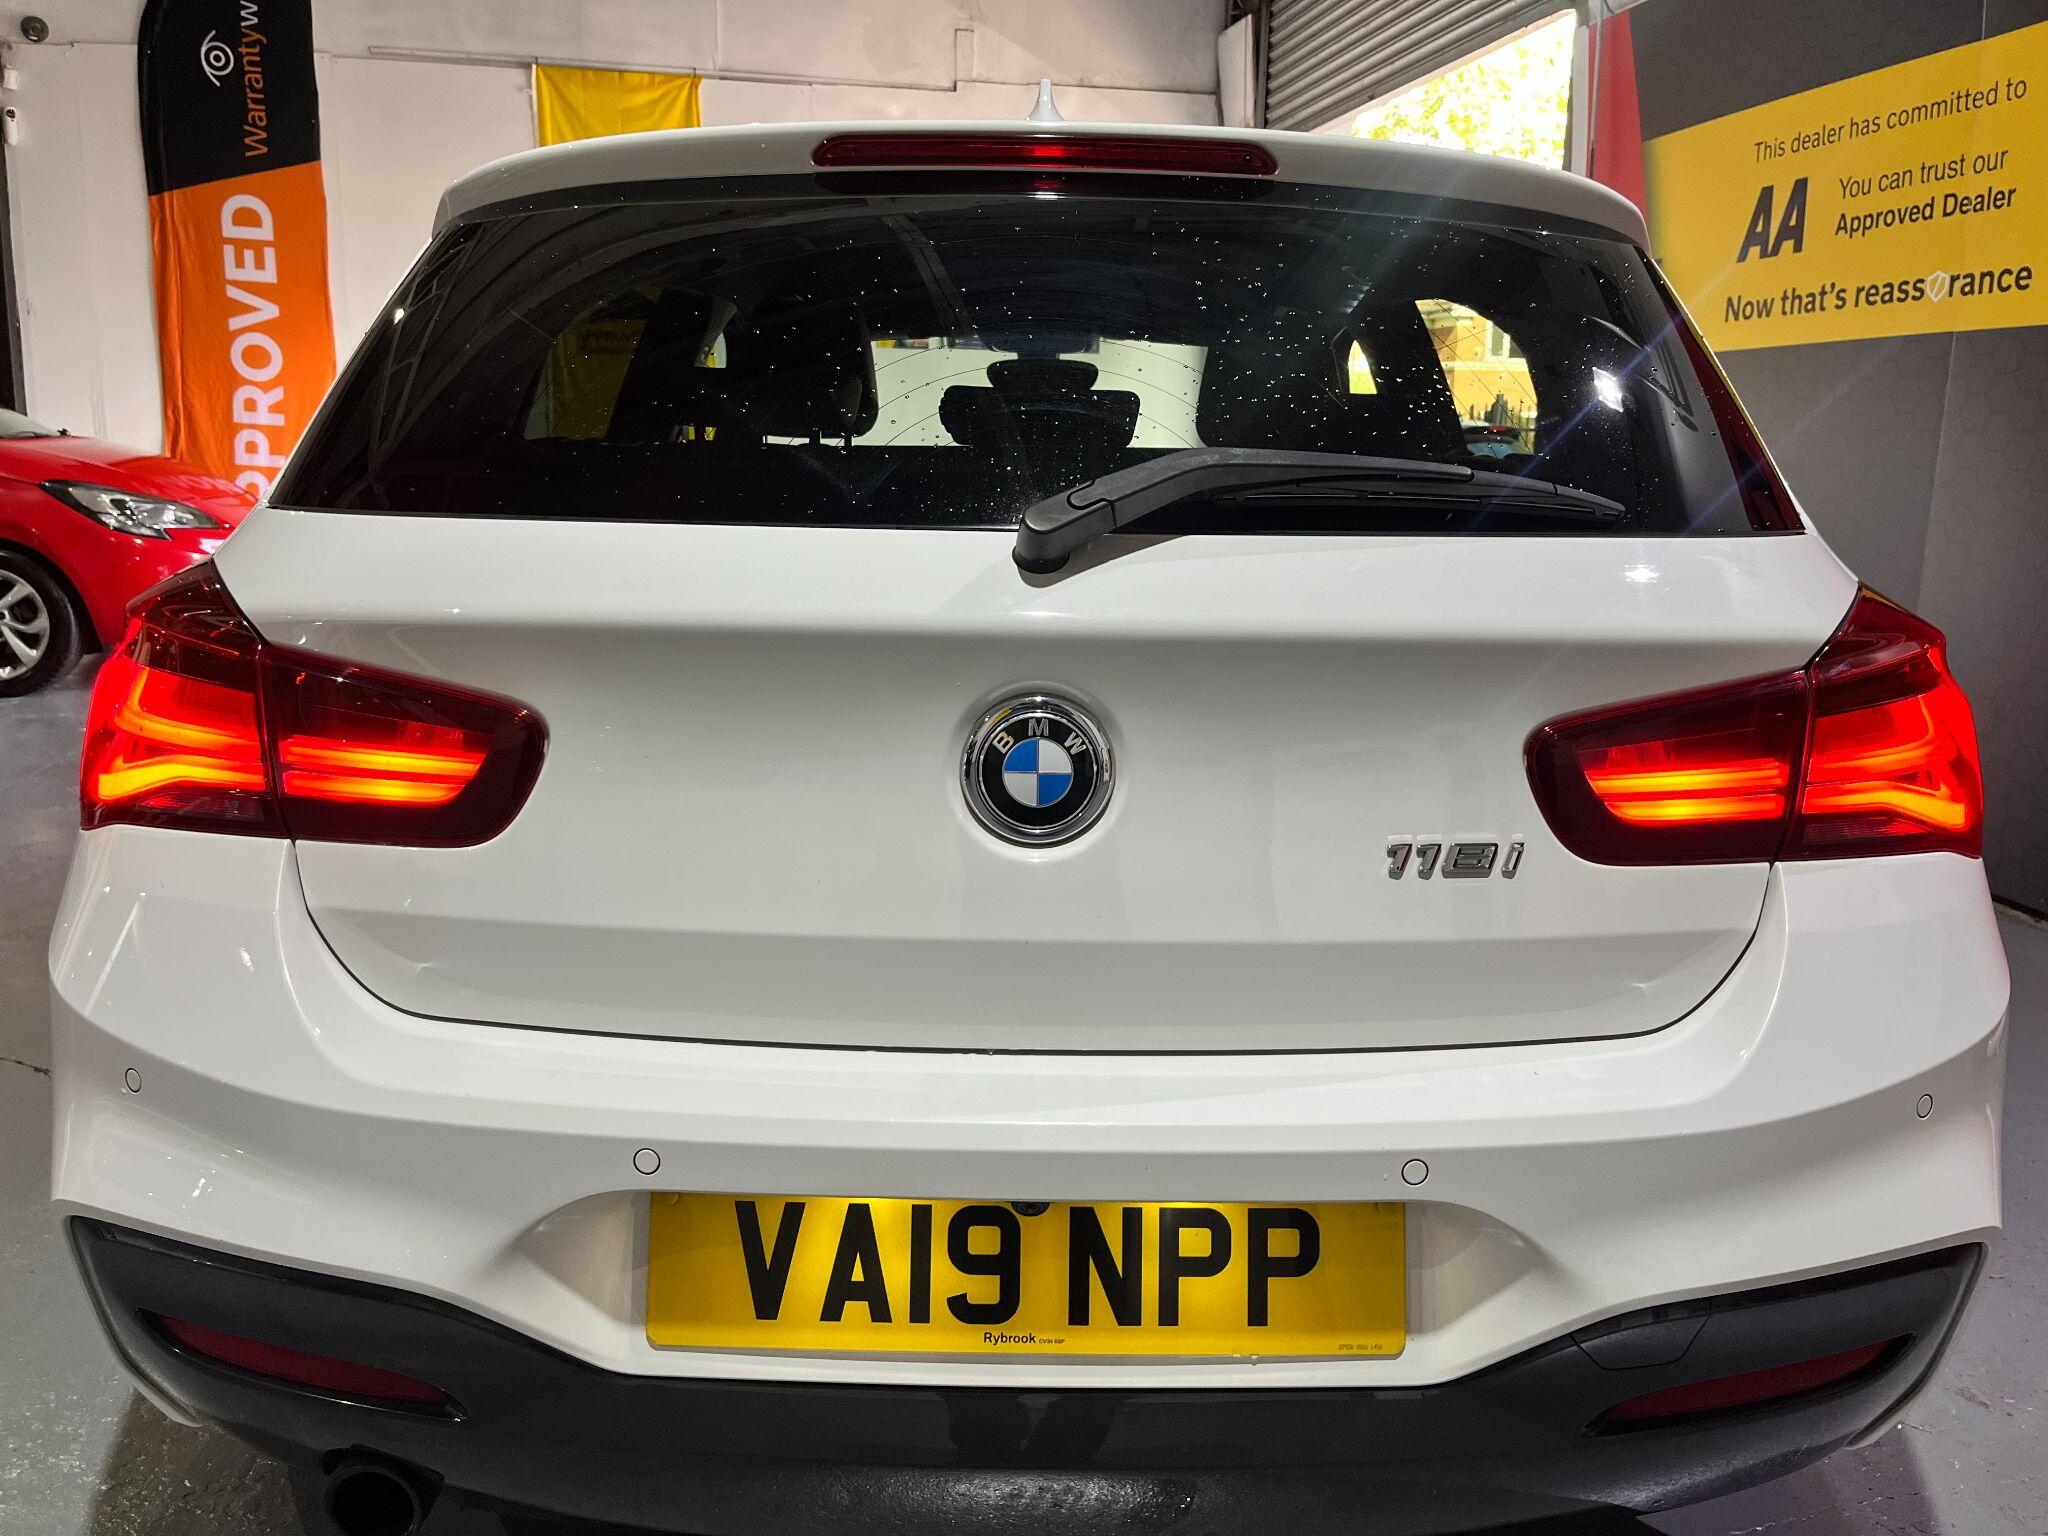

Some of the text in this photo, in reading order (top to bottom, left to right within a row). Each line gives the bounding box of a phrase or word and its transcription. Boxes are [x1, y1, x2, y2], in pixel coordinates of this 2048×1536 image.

[1754, 78, 2028, 163] This dealer has committed to
[1839, 150, 2009, 200] You can trust our
[1736, 177, 1809, 264] AA
[1835, 185, 2017, 238] Approved Dealer
[1724, 296, 1775, 323] Now
[992, 717, 1087, 755] BMW
[1386, 842, 1525, 880] 118i
[735, 1201, 1321, 1327] VA19 NPP
[983, 1332, 1036, 1345] Rybrook
